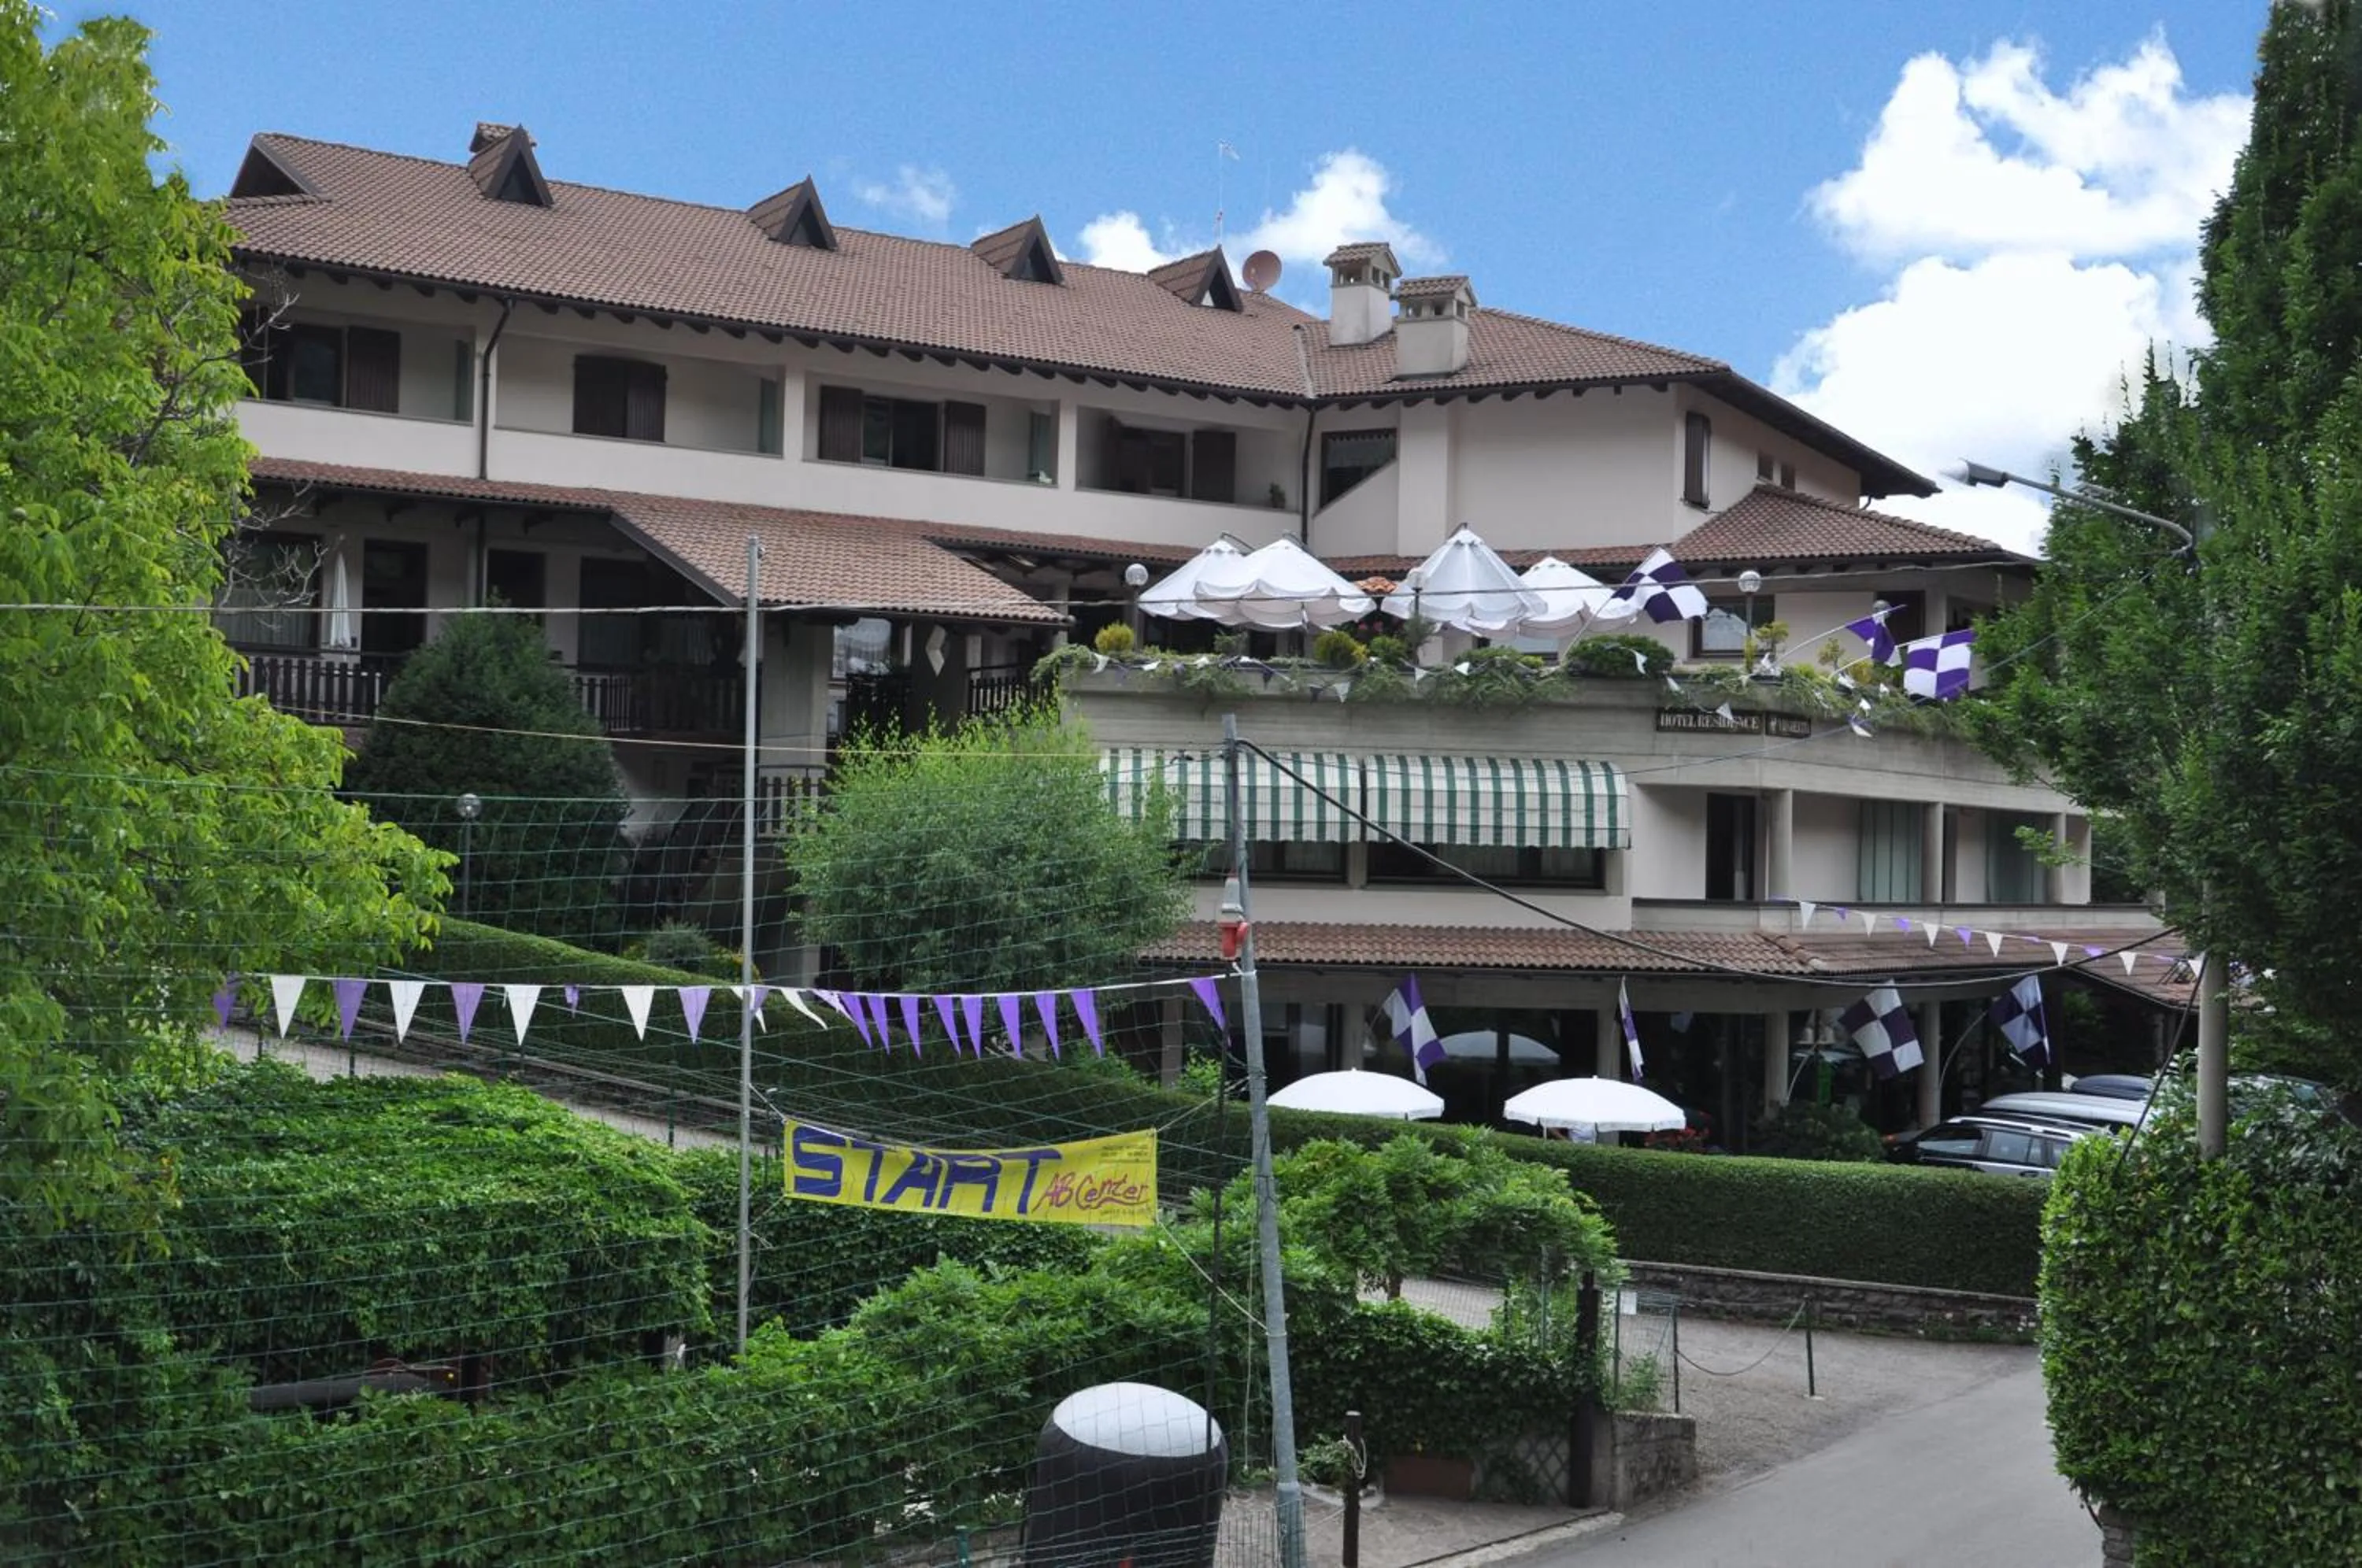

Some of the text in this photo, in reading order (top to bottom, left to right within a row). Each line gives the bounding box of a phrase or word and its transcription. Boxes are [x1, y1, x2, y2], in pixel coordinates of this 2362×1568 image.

[1660, 714, 1696, 728] HOTEL
[793, 1126, 1061, 1214] START
[1075, 1173, 1150, 1211] Center
